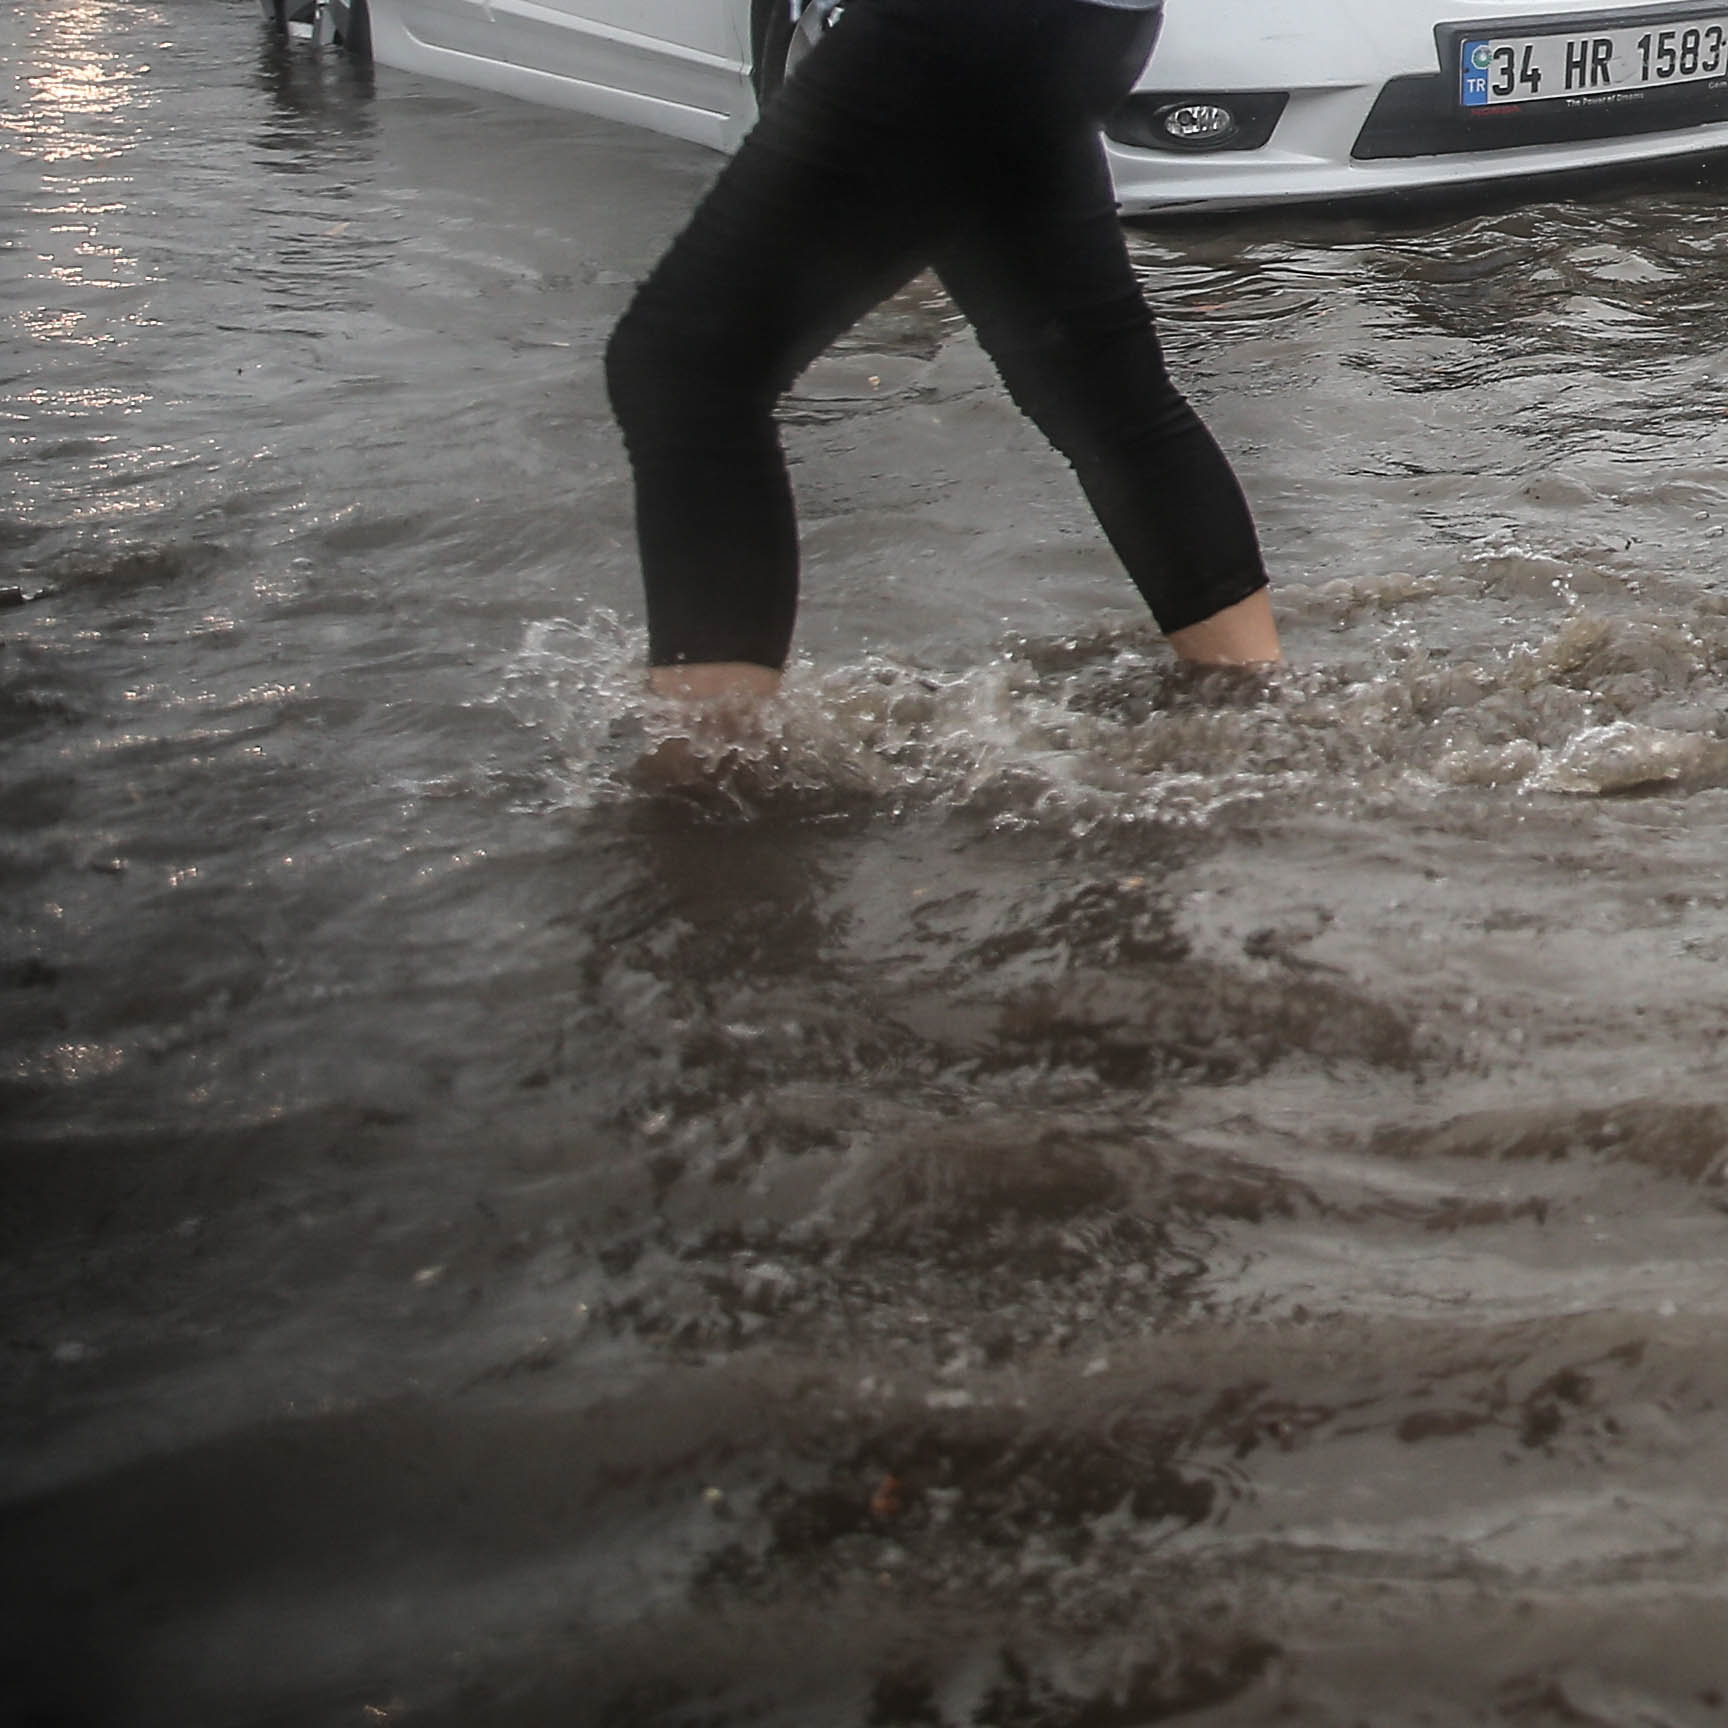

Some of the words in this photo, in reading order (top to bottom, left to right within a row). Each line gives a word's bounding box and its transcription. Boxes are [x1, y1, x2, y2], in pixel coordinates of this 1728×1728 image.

[1491, 45, 1542, 97] 34
[1564, 38, 1614, 90] HR
[1637, 25, 1723, 81] 1583
[1467, 78, 1486, 93] TR
[1566, 98, 1581, 108] The
